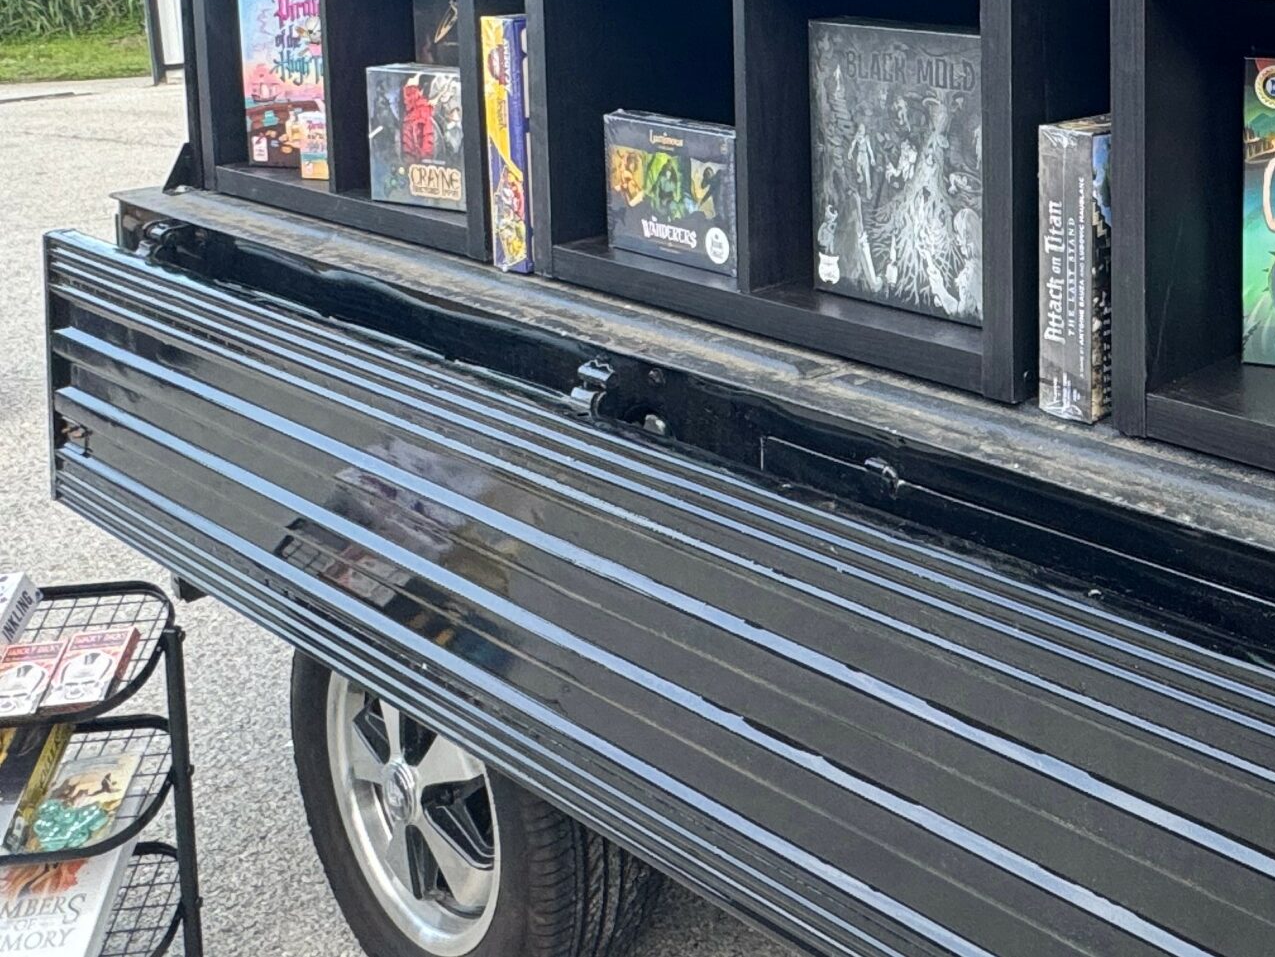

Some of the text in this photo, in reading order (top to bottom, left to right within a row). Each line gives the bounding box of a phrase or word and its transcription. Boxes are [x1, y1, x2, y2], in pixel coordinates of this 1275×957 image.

[269, 50, 309, 86] High
[846, 50, 976, 92] BLACK MOLD
[641, 216, 698, 249] WANDERERS
[1067, 217, 1075, 262] STAND
[1044, 200, 1065, 344] Attack on Titan
[1067, 268, 1076, 303] LAST
[2, 590, 34, 643] INKLING
[14, 918, 37, 931] OF
